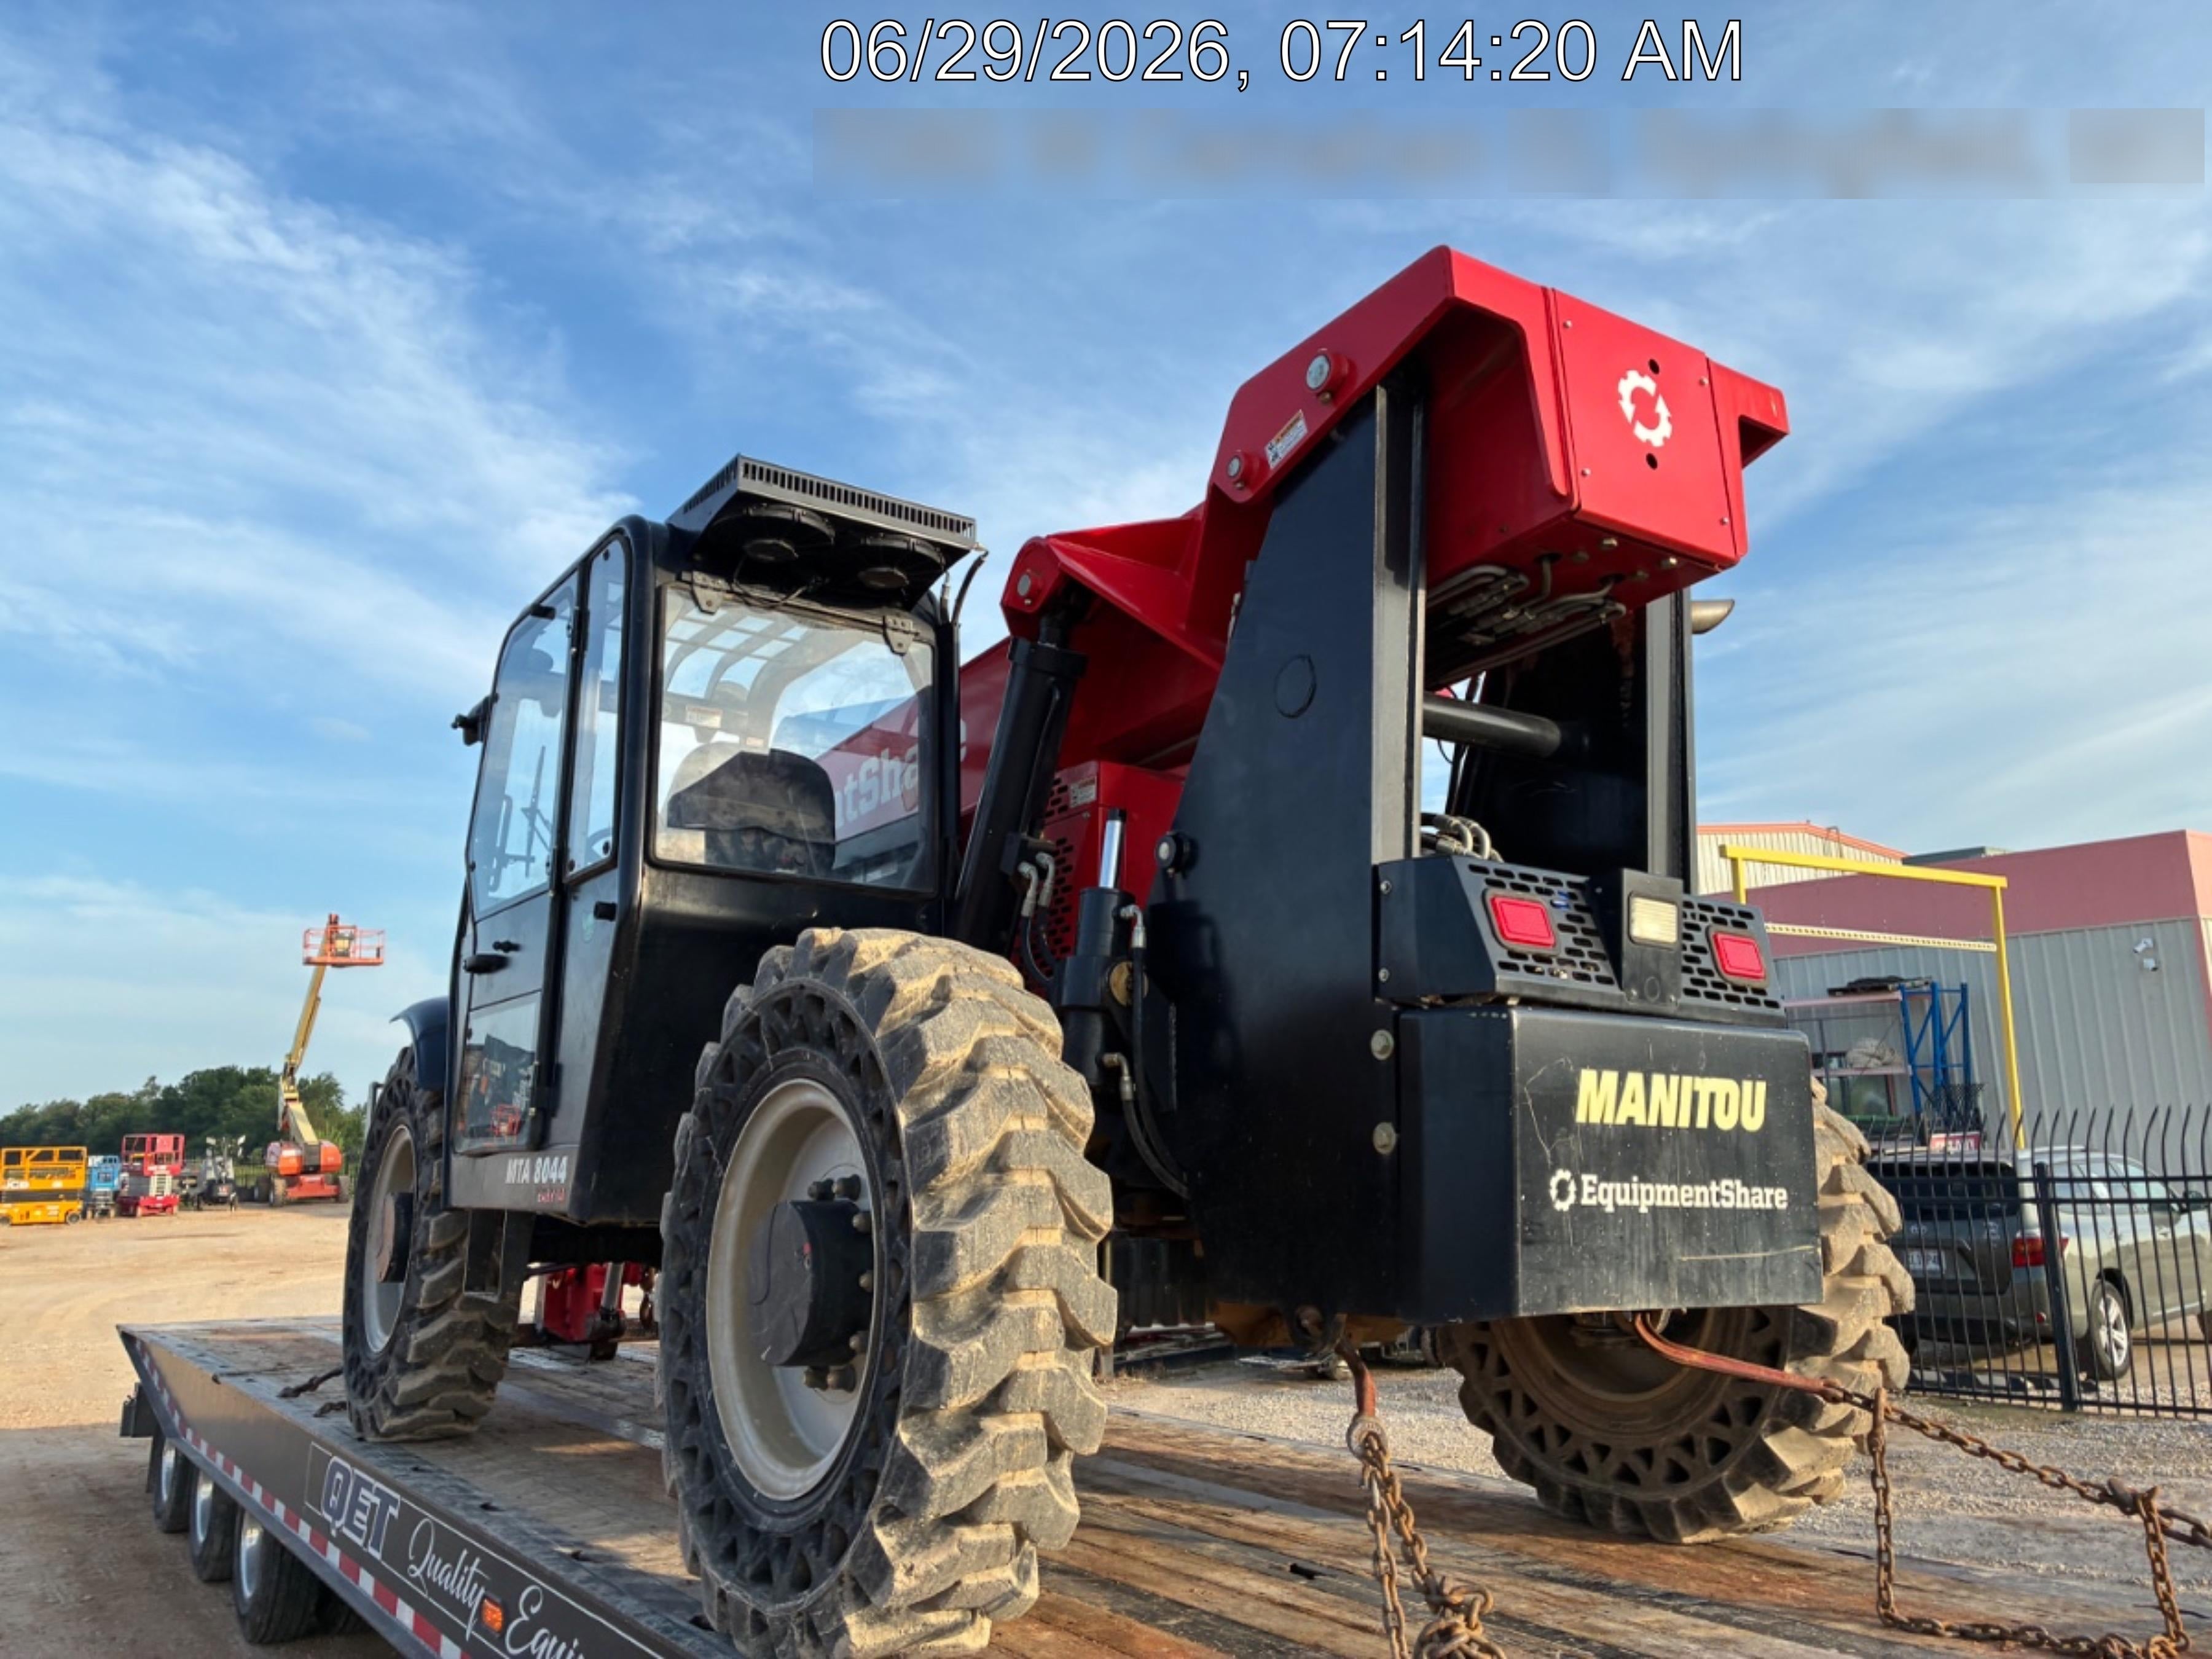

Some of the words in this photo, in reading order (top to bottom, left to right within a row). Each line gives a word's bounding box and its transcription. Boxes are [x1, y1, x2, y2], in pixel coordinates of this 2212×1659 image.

[1576, 1069, 1767, 1132] MANITOU
[534, 1156, 568, 1184] 8044
[1581, 1174, 1789, 1214] EquipmentShare
[321, 1455, 401, 1561] QET
[407, 1518, 490, 1641] Quality
